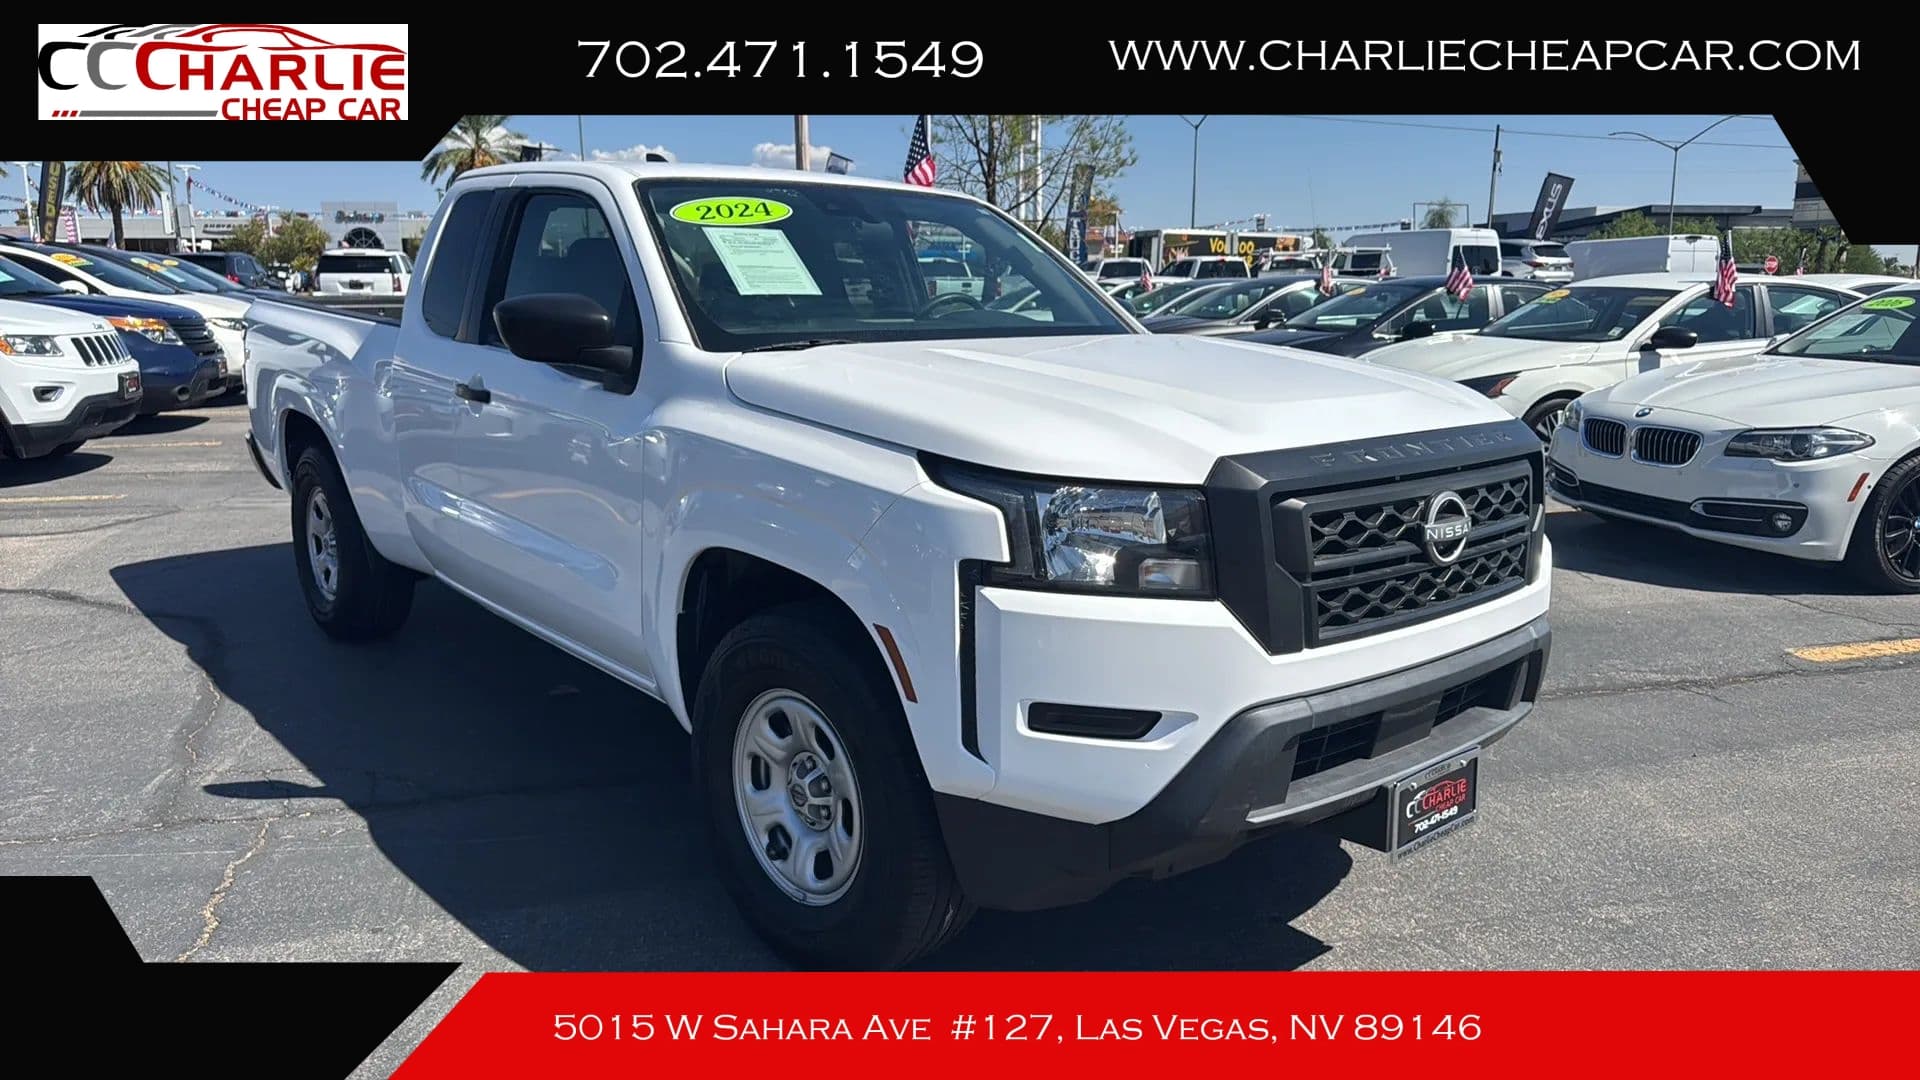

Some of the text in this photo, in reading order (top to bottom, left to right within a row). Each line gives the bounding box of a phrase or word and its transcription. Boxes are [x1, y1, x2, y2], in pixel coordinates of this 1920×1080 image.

[695, 202, 774, 220] 2024
[1535, 183, 1563, 241] EXUS
[1069, 217, 1082, 265] TRUC
